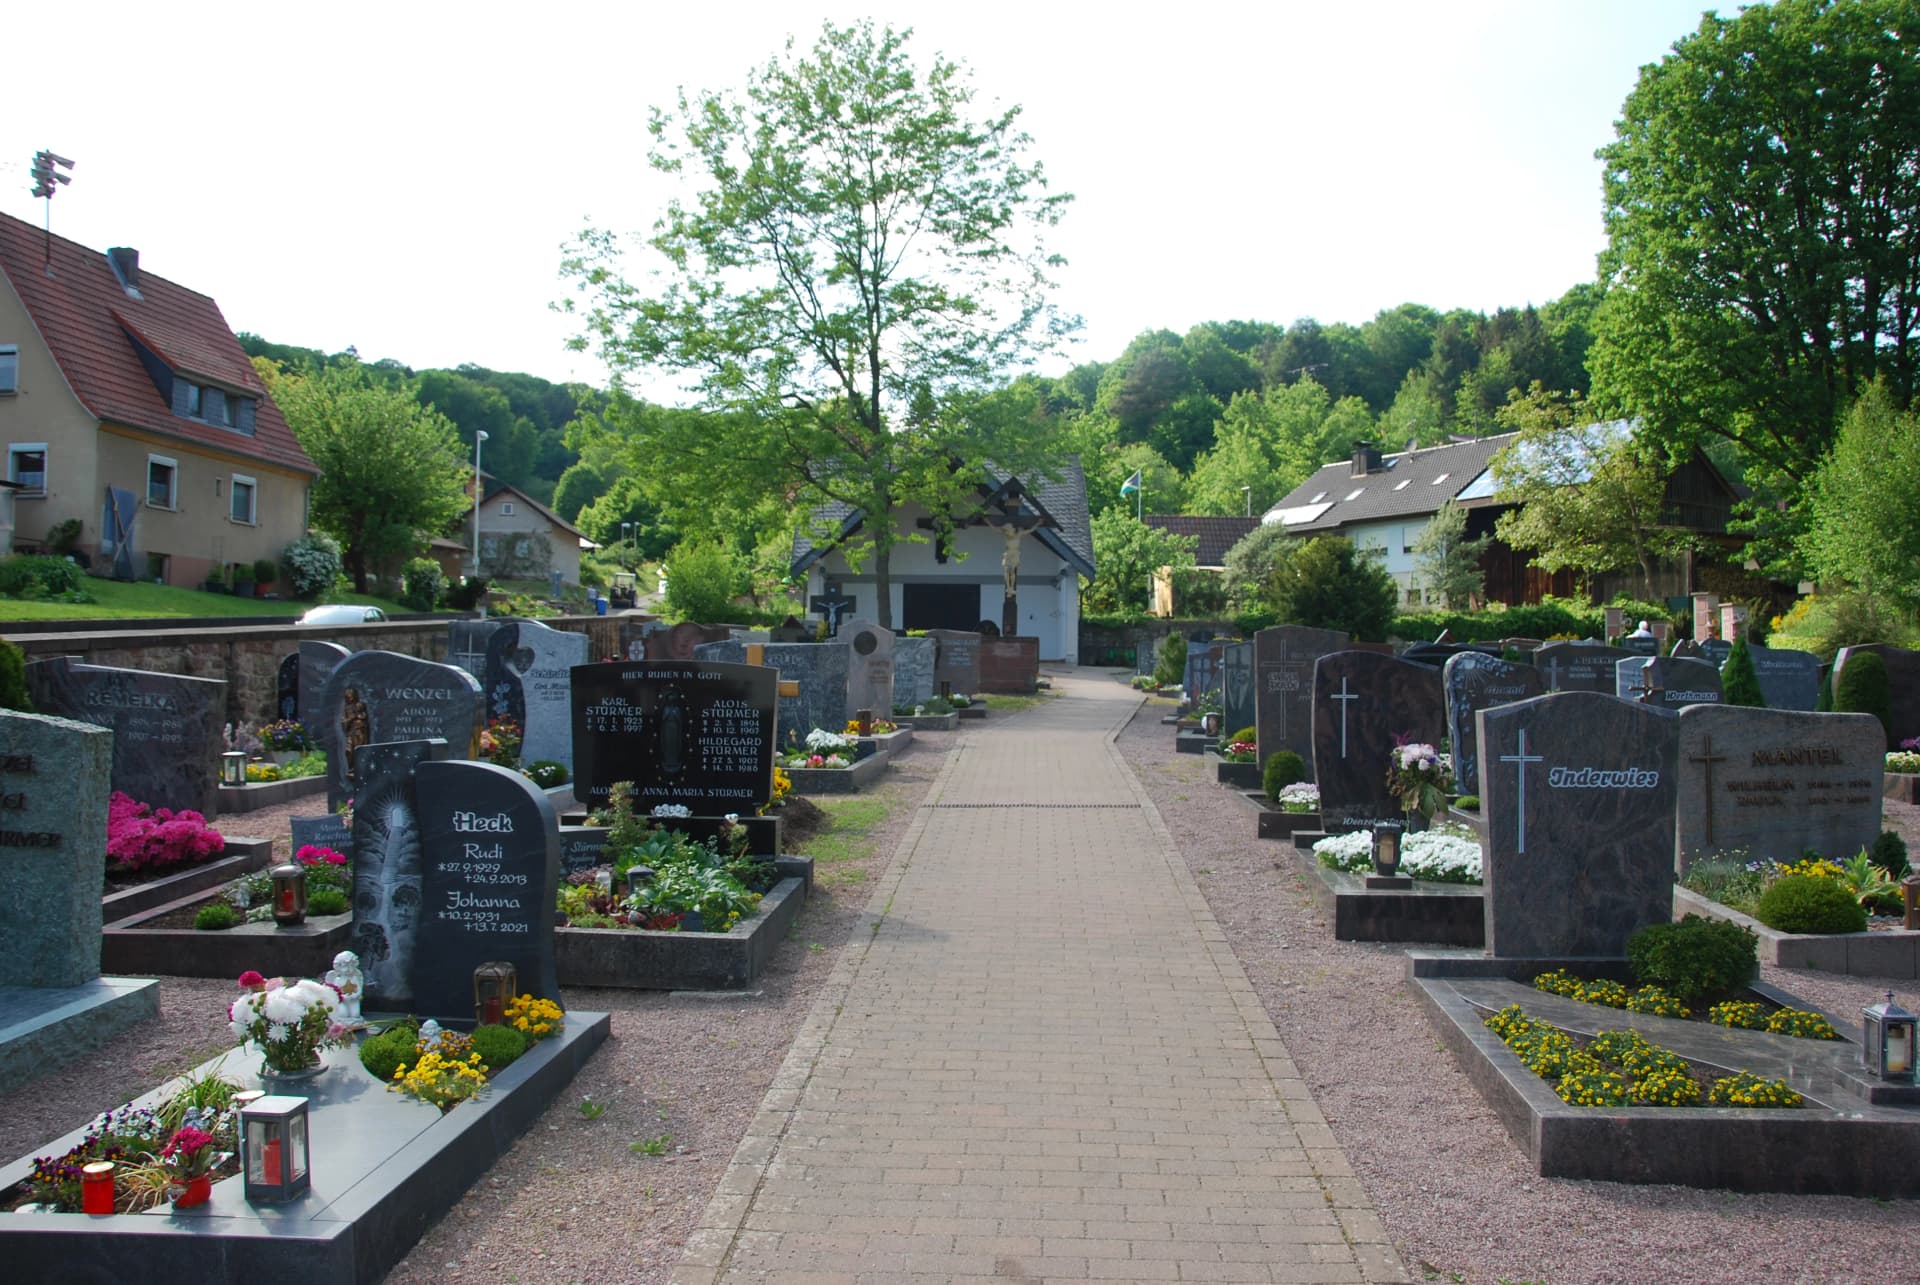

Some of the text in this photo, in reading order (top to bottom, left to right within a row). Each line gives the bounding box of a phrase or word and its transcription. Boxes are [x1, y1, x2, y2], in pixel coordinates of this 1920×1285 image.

[385, 687, 452, 700] WENZEL
[601, 697, 628, 706] KARL
[698, 737, 762, 746] HILDEGARD
[1752, 750, 1843, 767] MANTEL
[1549, 767, 1659, 788] Inderwies
[452, 811, 514, 832] Heck
[463, 843, 503, 859] Rudi
[446, 891, 521, 910] Johanna
